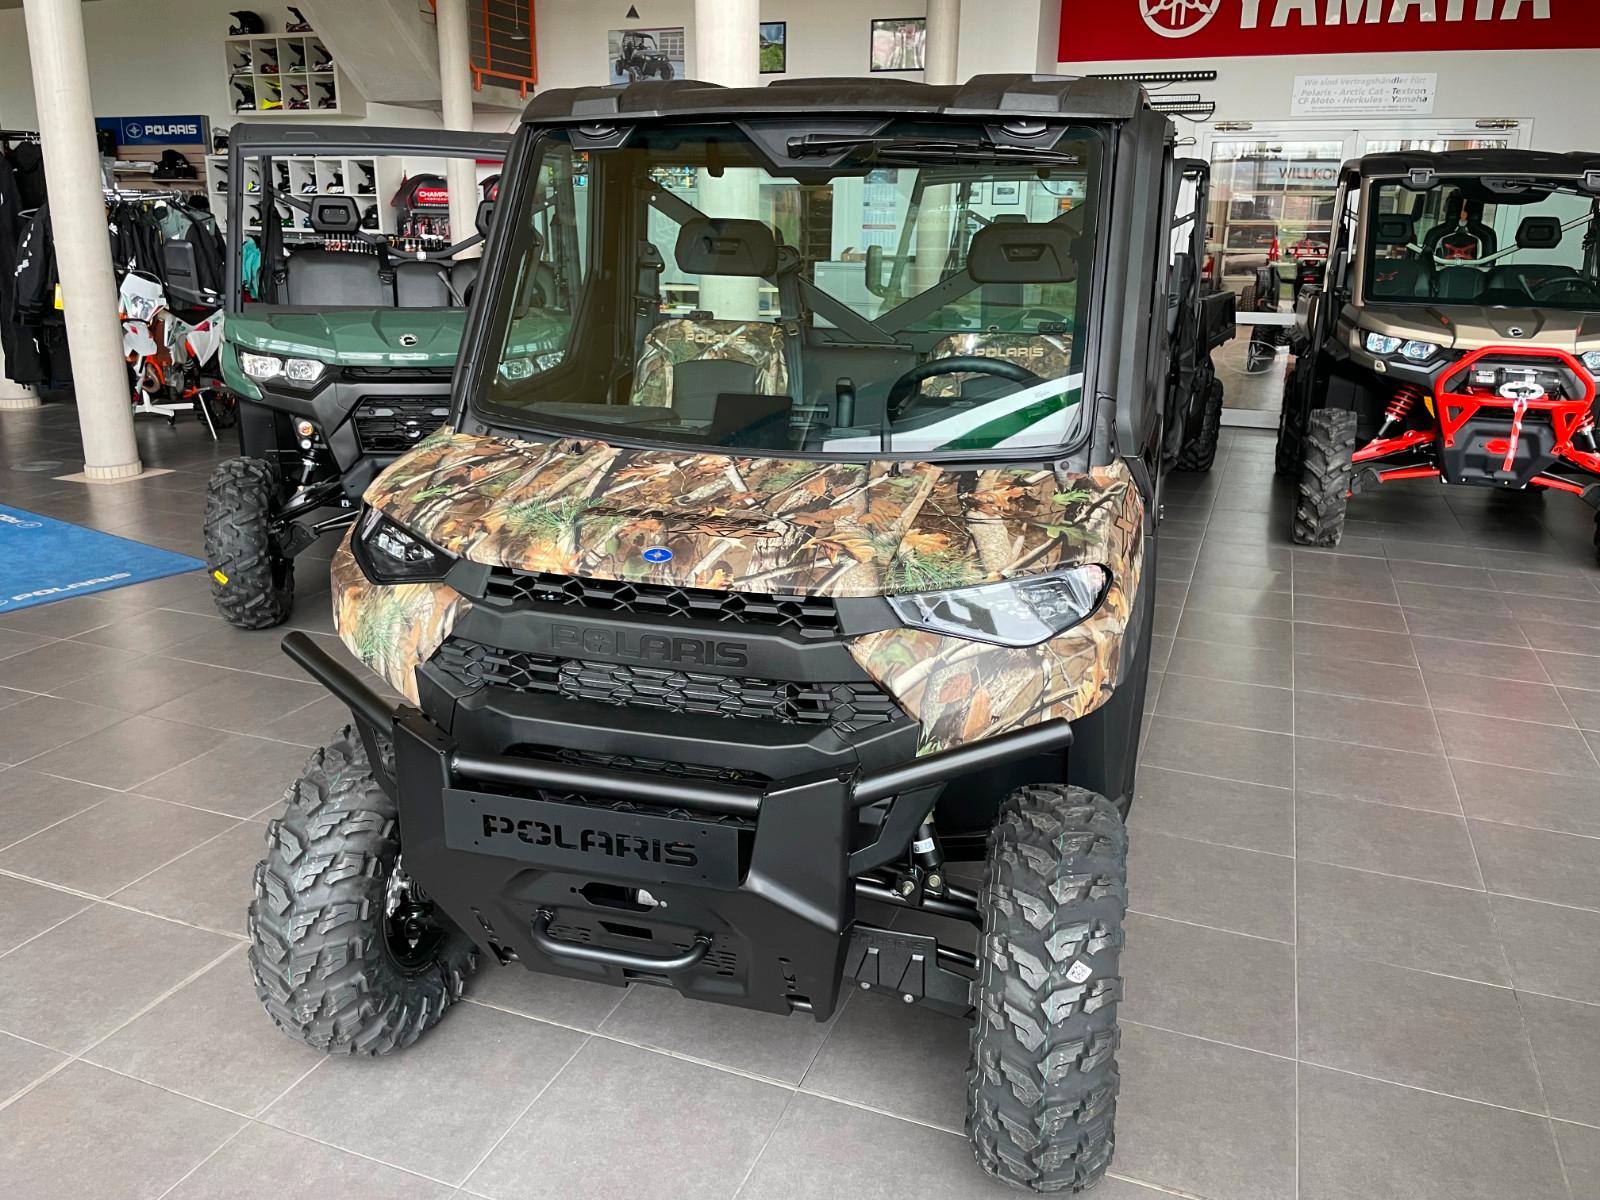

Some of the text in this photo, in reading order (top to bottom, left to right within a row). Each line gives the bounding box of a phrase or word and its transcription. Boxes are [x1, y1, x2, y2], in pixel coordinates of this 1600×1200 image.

[1392, 87, 1427, 95] Textron
[1392, 95, 1428, 103] Yamaha
[145, 124, 198, 136] POLARIS
[975, 347, 1044, 358] POLARIS
[11, 571, 132, 601] POLARIS
[552, 623, 748, 668] POLARIS
[482, 813, 699, 868] POLARIS
